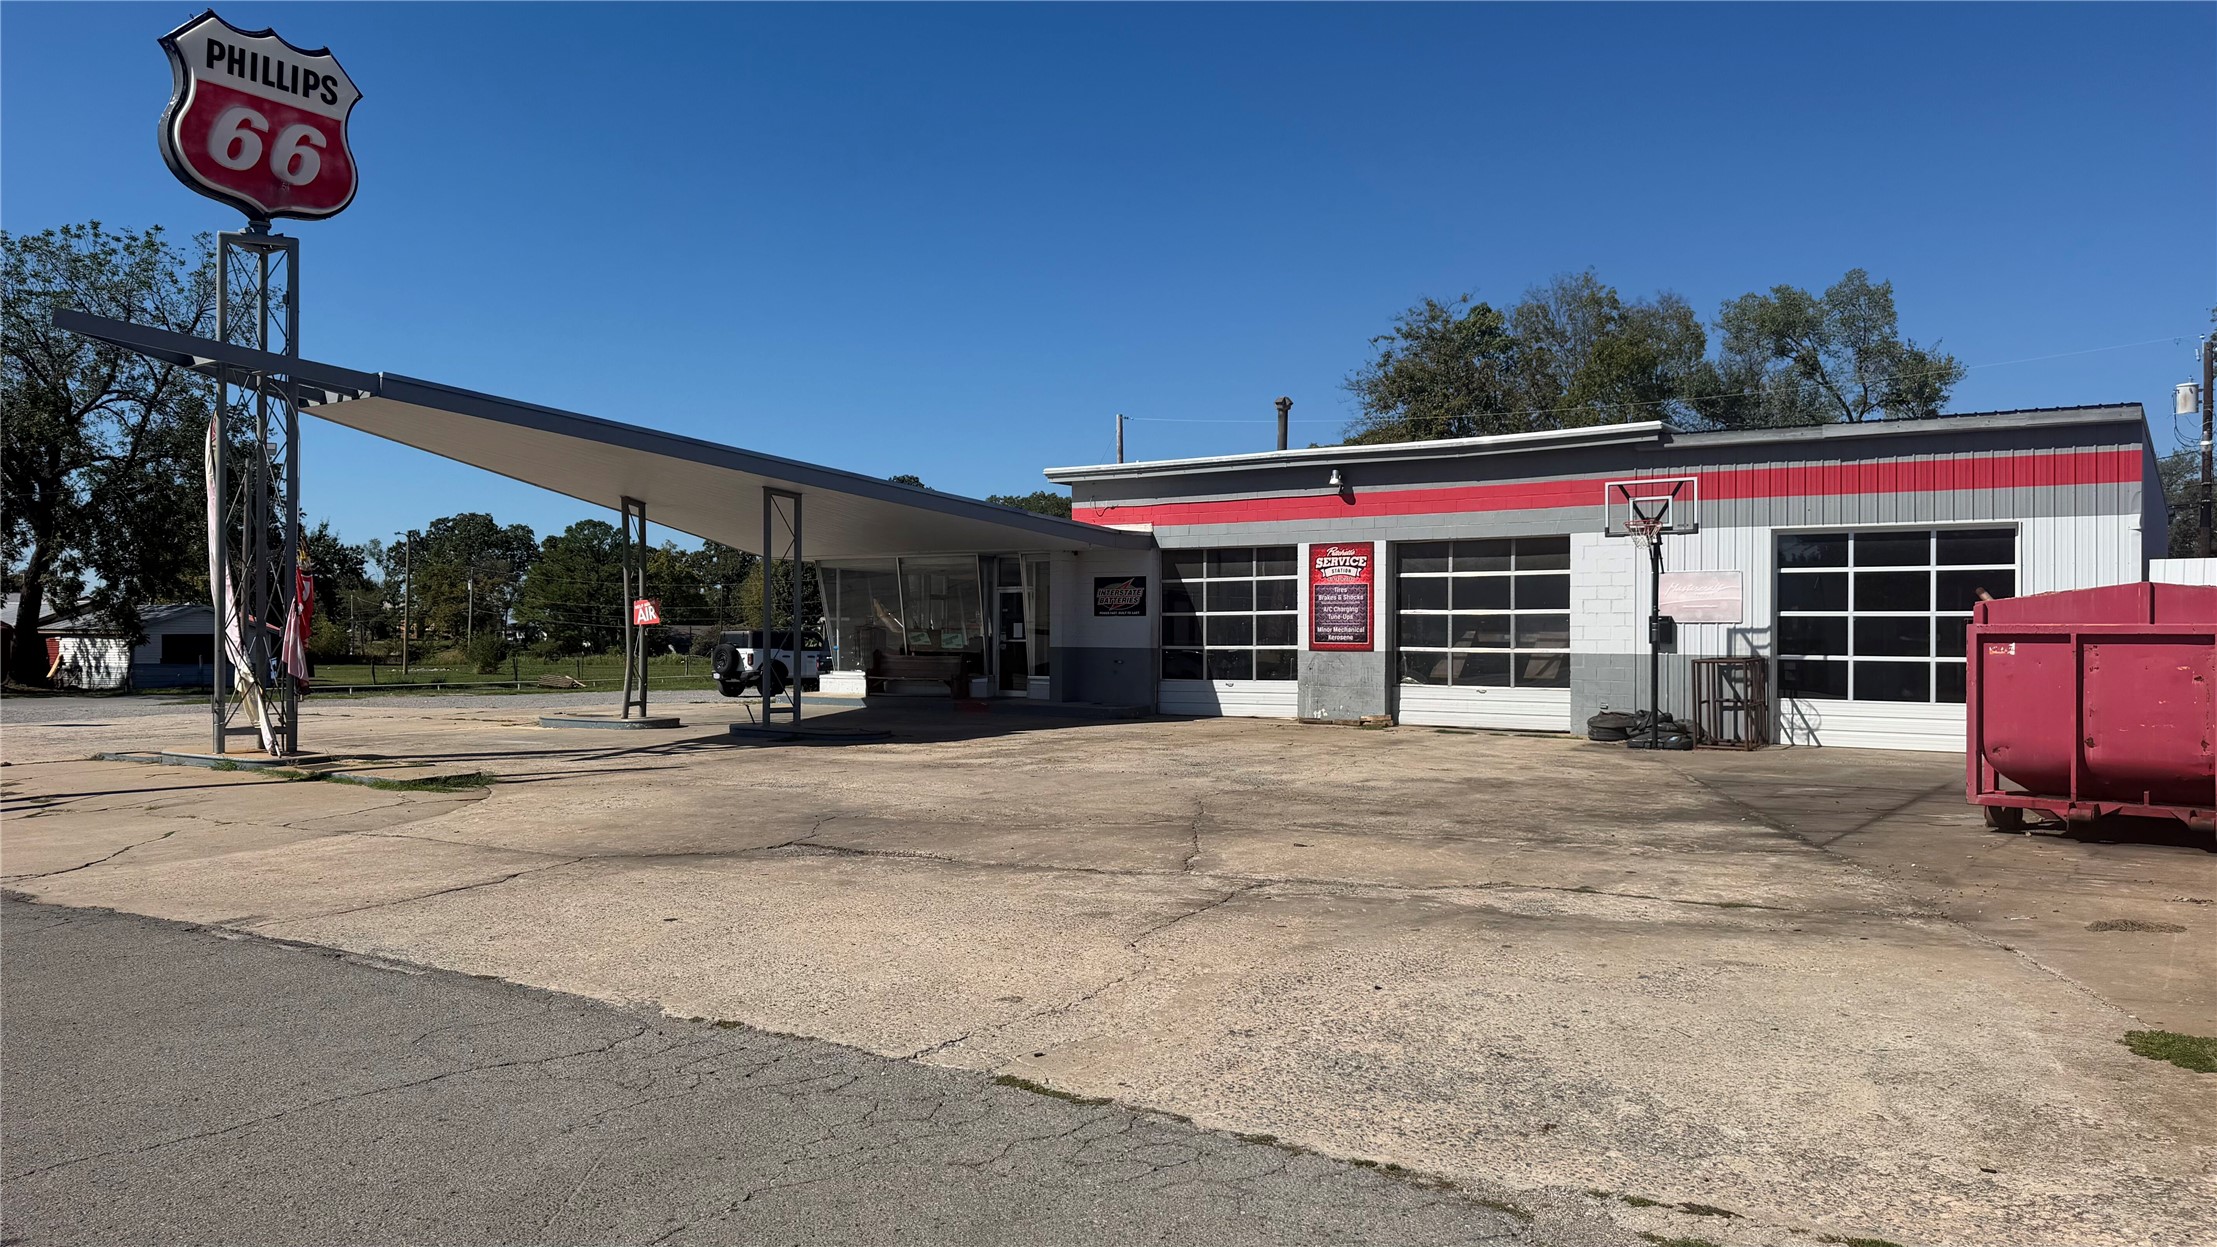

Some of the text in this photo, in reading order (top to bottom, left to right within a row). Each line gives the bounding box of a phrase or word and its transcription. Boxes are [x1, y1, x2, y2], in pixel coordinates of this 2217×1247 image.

[206, 37, 338, 106] PHILLIPS
[207, 106, 327, 187] 66
[1315, 556, 1368, 569] SERVICE
[637, 605, 657, 624] AIR
